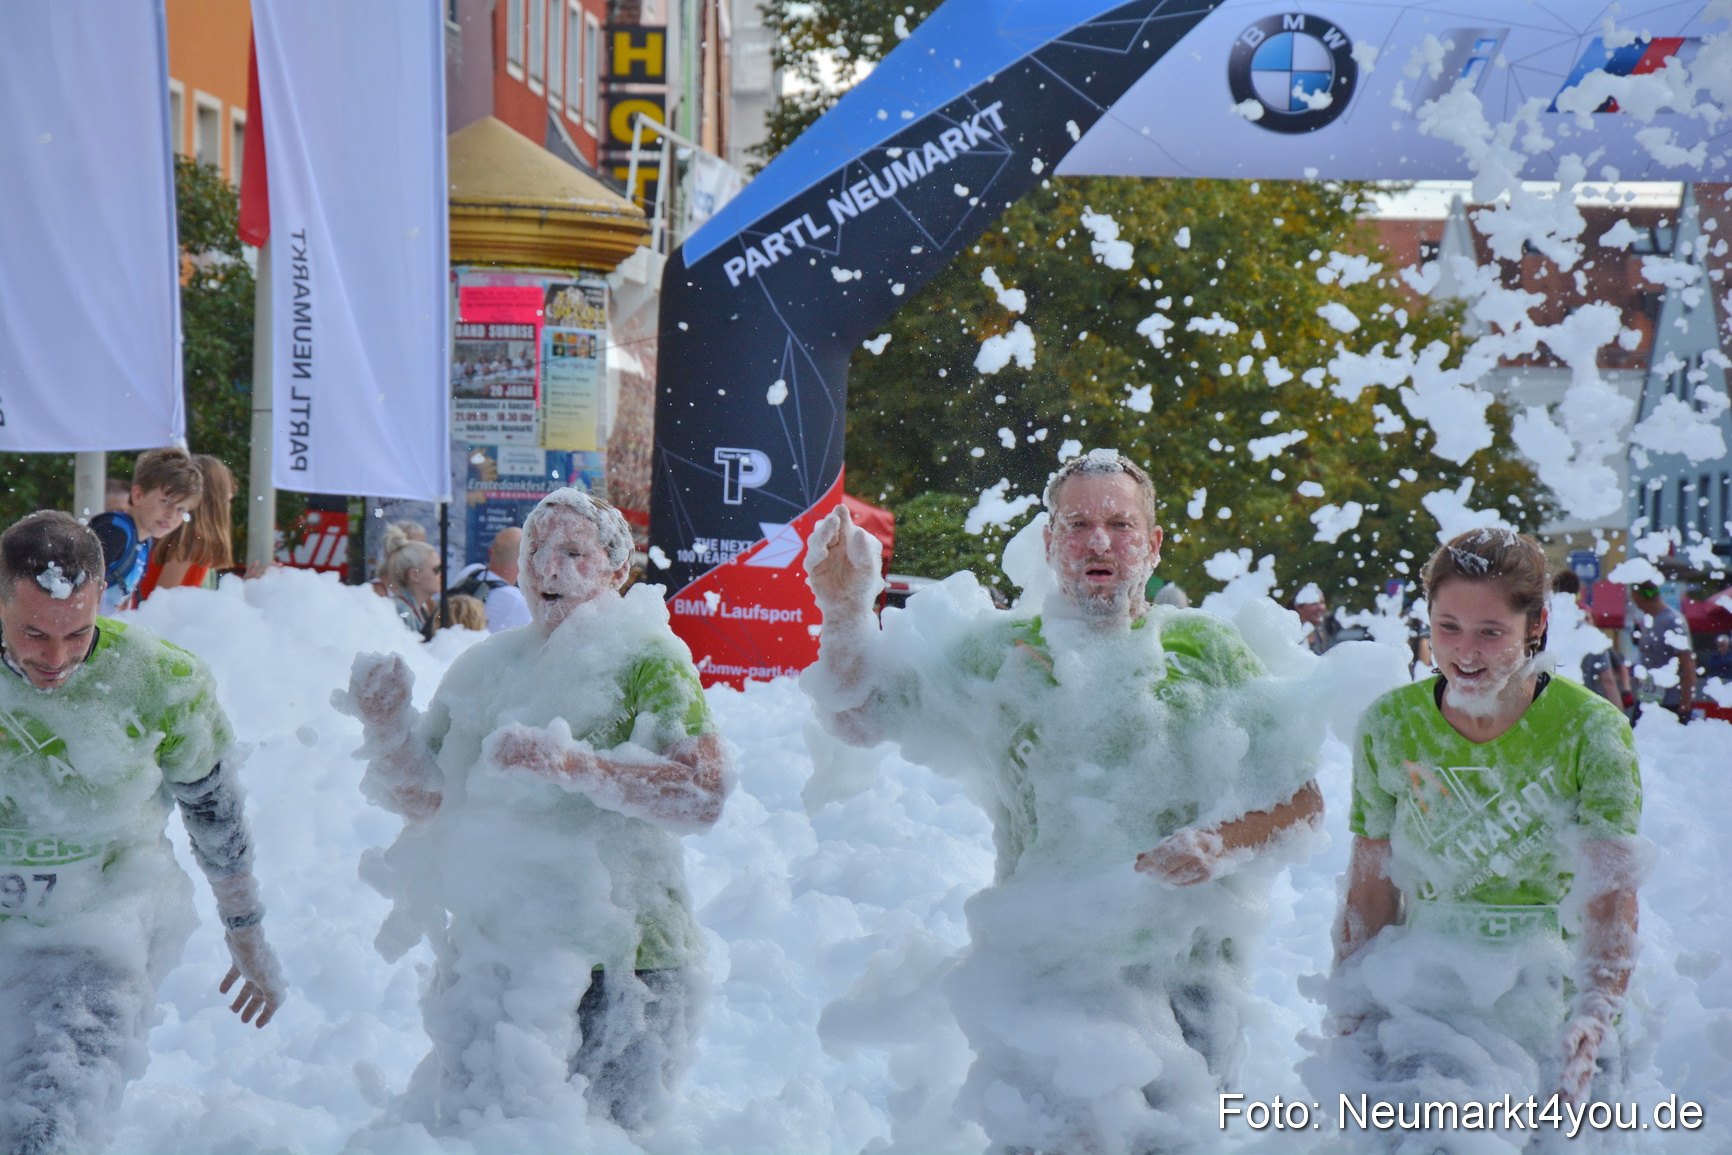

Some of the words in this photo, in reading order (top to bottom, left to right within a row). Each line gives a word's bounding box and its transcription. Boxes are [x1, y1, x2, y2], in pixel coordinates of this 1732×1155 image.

[1241, 14, 1348, 50] BMW
[723, 212, 832, 287] PARTL
[826, 100, 1008, 226] NEUMARKT
[467, 478, 543, 492] Erntedankfest
[720, 539, 753, 553] NEXT
[677, 549, 696, 563] 100
[696, 550, 738, 566] YEARS
[674, 598, 718, 618] BMW
[720, 602, 803, 624] Laufsport
